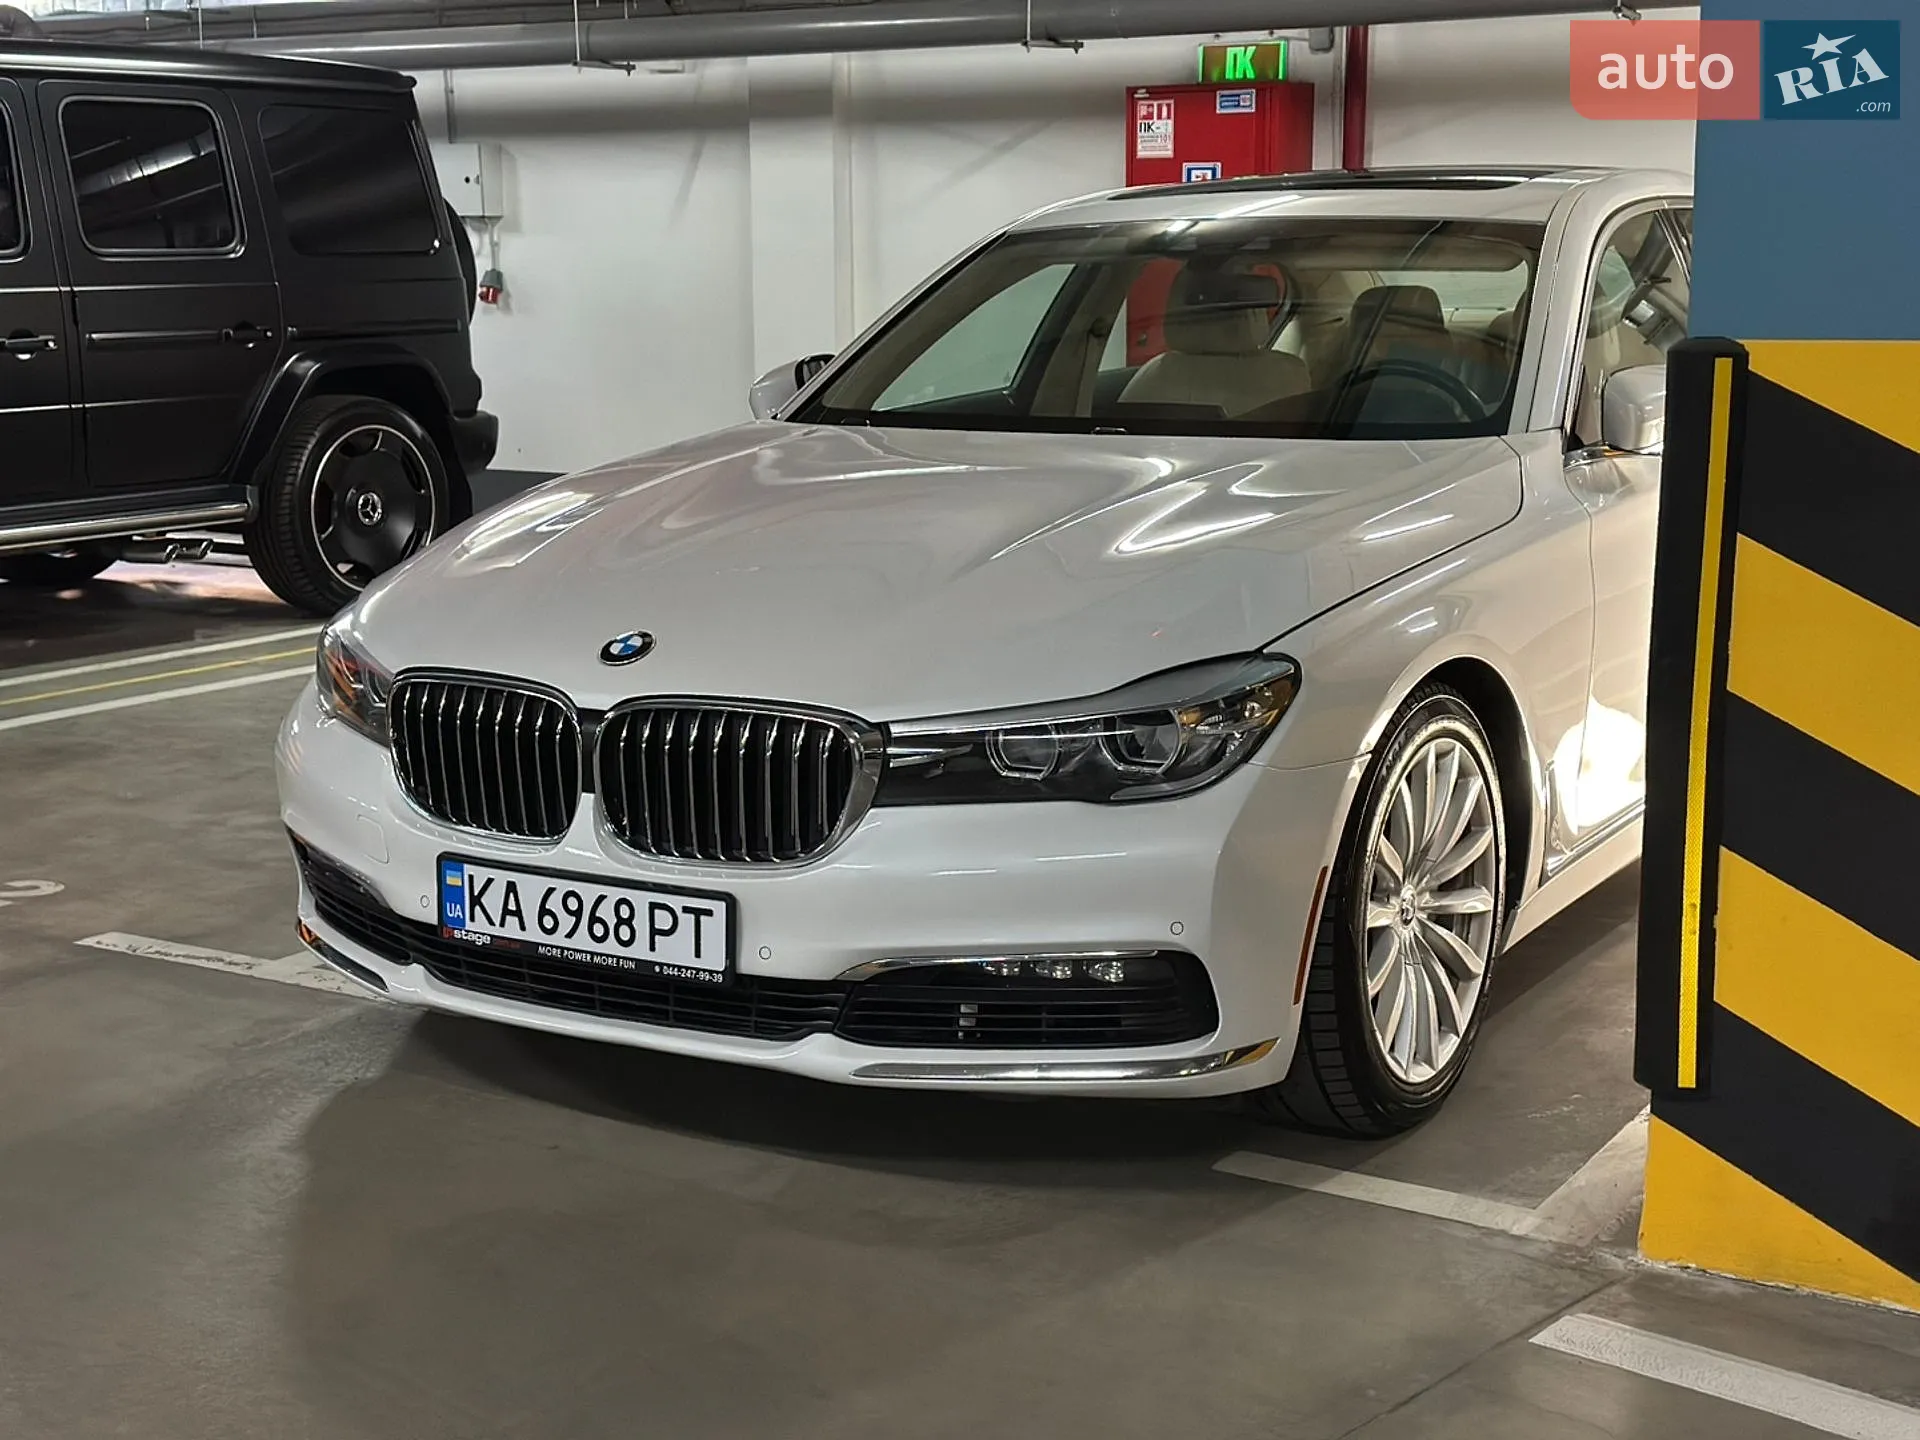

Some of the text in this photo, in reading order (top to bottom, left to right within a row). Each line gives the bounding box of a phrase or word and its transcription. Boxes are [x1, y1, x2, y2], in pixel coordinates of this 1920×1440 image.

[1226, 46, 1256, 79] ПК
[446, 902, 463, 920] UA
[468, 873, 714, 959] KA 6968 PT
[537, 945, 636, 970] MORE POWER MORE FUN
